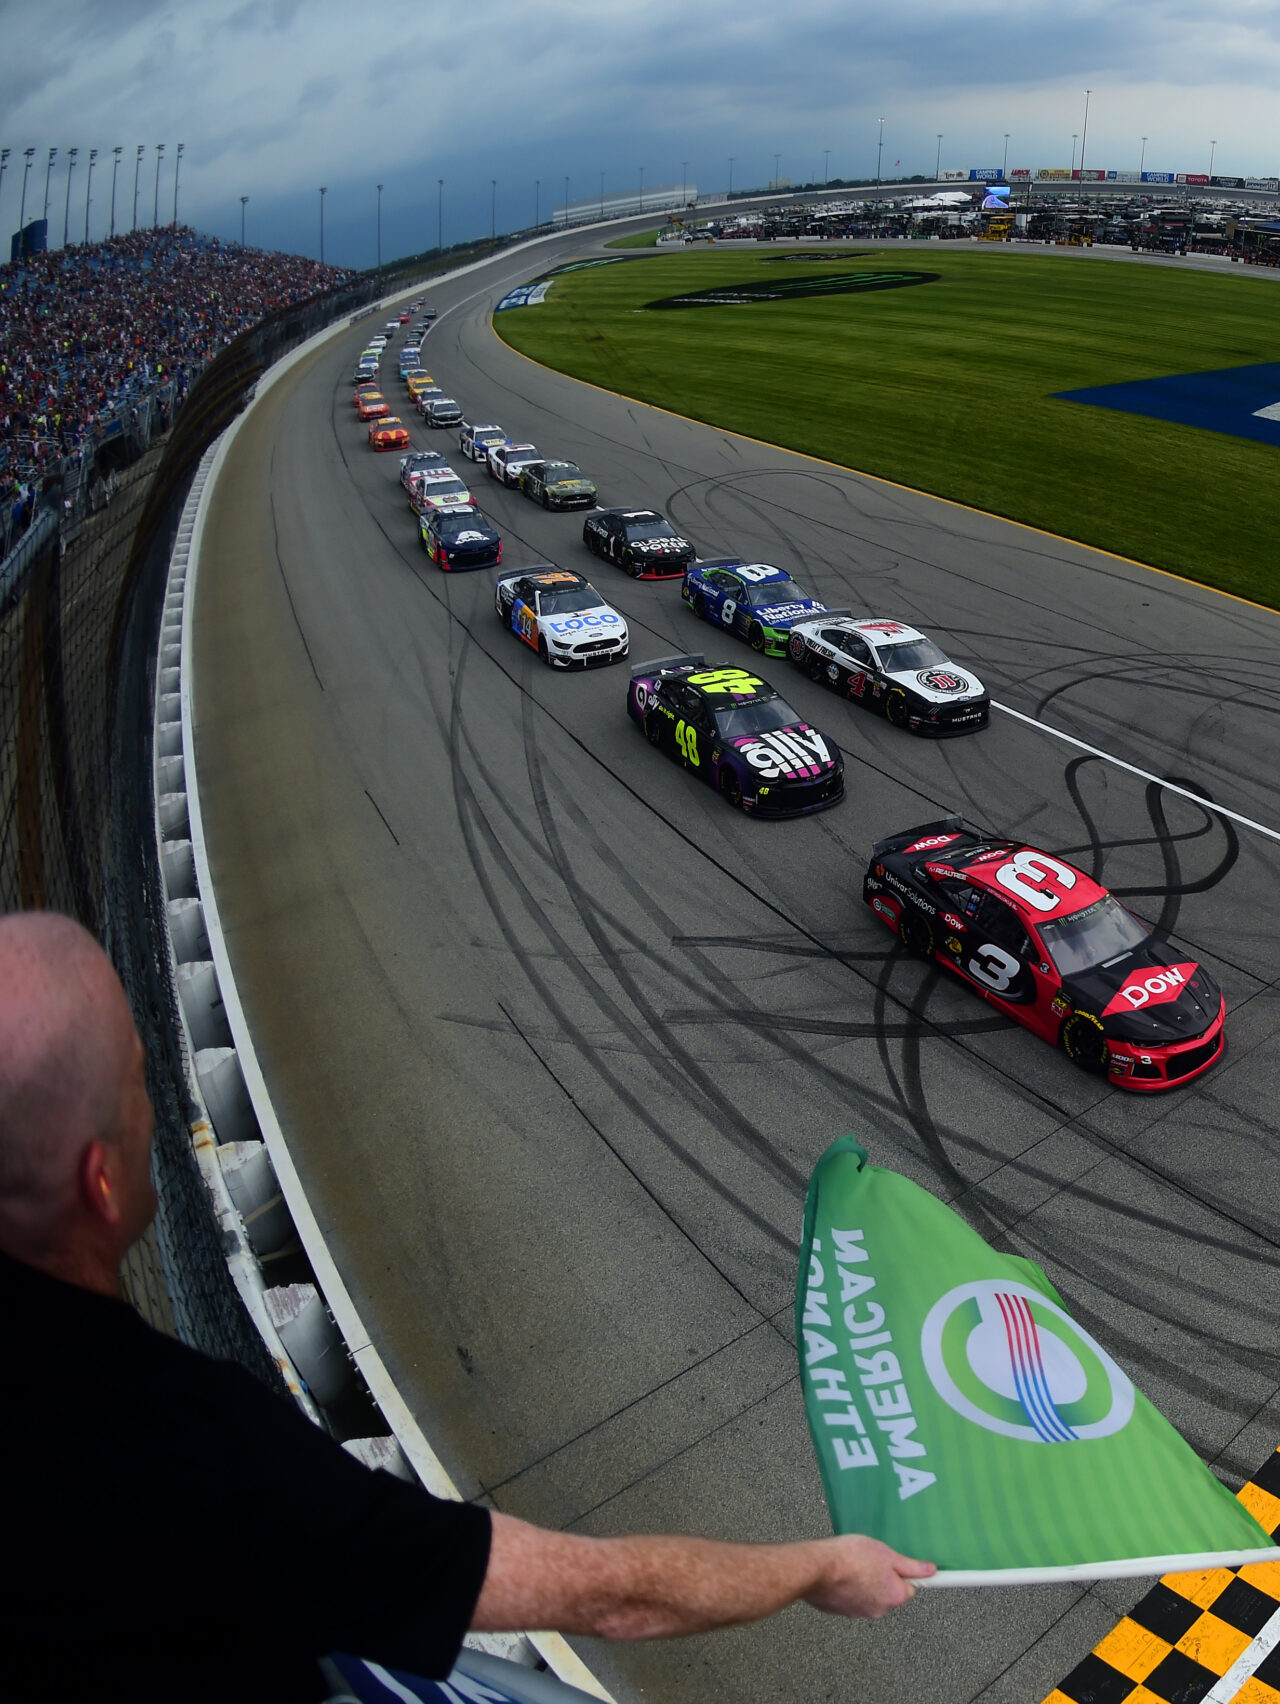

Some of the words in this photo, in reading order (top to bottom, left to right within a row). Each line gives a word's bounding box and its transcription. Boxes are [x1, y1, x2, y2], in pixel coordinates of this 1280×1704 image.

[609, 535, 615, 557] 1
[630, 536, 688, 548] GLOBAL
[640, 541, 690, 552] POKER
[736, 563, 780, 582] 8
[721, 599, 737, 625] 8
[756, 602, 806, 616] Liberty
[762, 607, 822, 623] National
[520, 614, 532, 640] 14
[687, 669, 764, 695] 48
[847, 671, 867, 698] 4
[952, 712, 983, 723] MUSTANG
[675, 719, 700, 767] 48
[738, 728, 832, 778] ally
[758, 787, 769, 795] 48
[995, 851, 1077, 912] 3
[968, 943, 1021, 991] 3
[1140, 1055, 1152, 1065] 3
